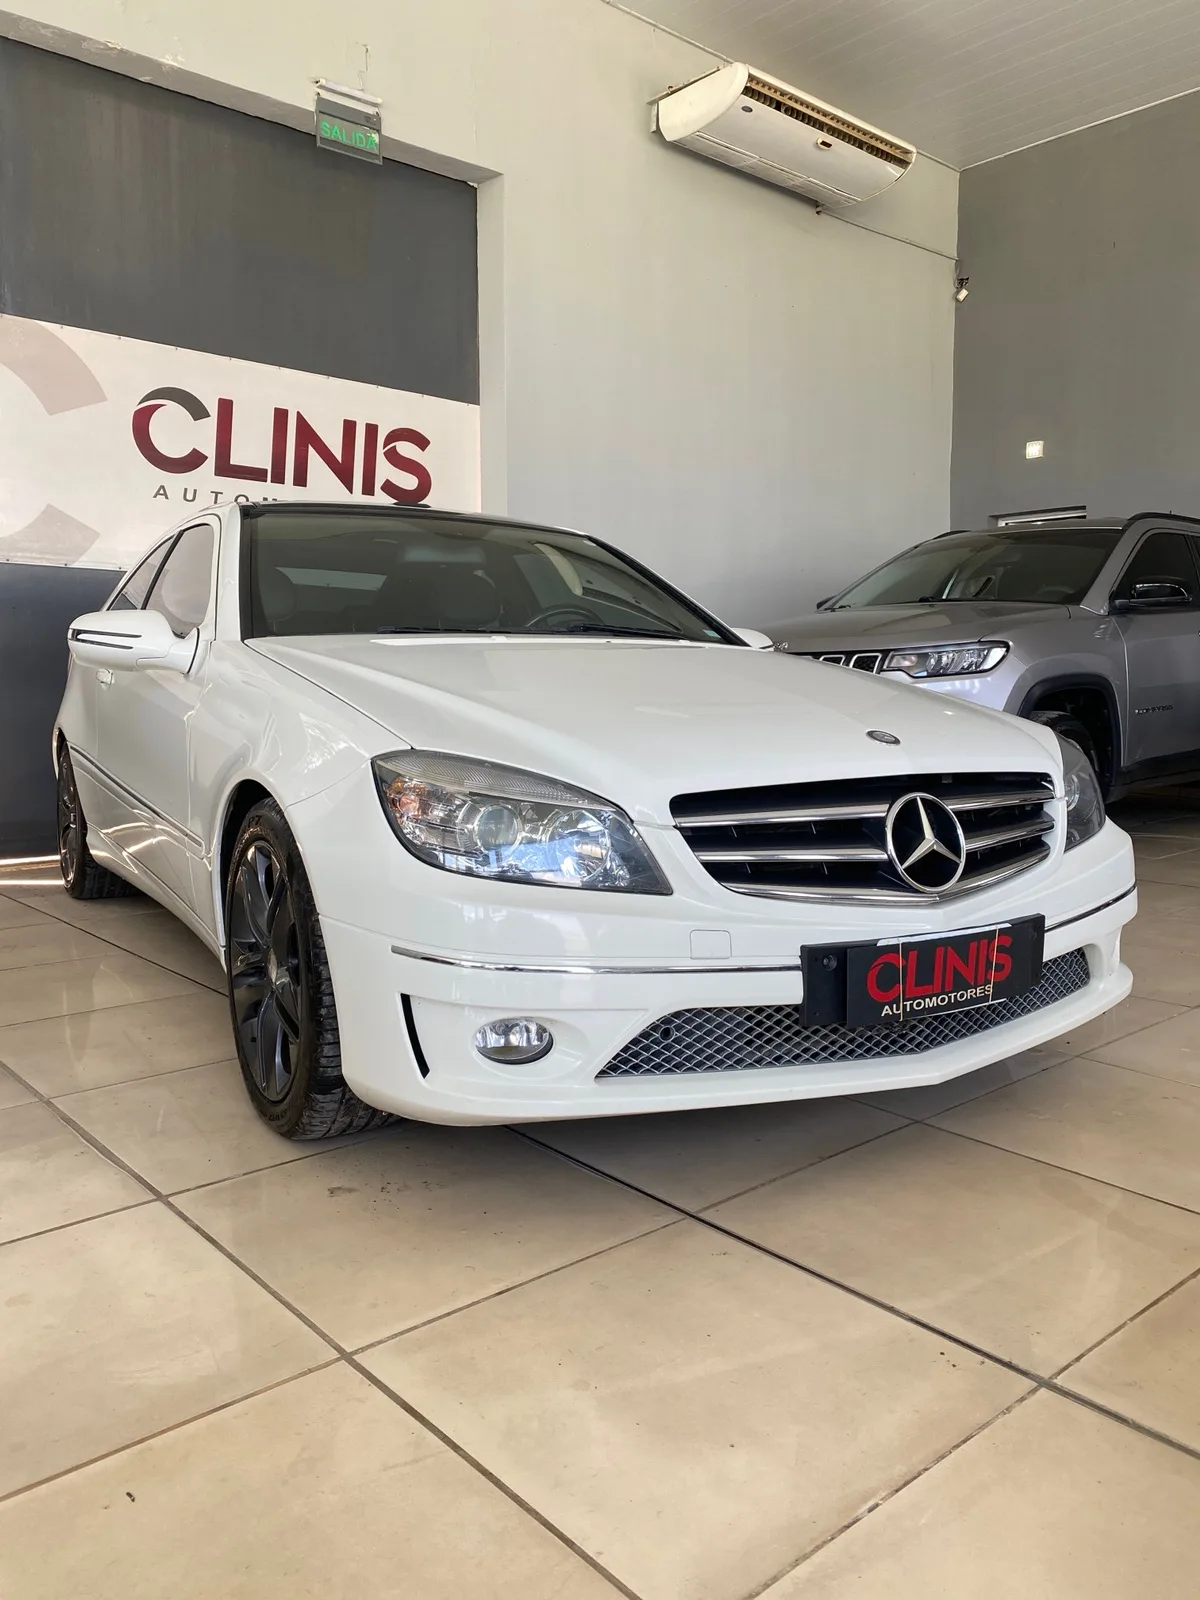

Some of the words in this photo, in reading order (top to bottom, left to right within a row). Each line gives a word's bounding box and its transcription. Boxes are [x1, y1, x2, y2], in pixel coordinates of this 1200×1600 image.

[321, 121, 377, 152] SALIDA
[132, 386, 432, 503] CLINIS
[867, 936, 1013, 1003] CLINIS
[881, 984, 993, 1017] AUTOMOTORES
